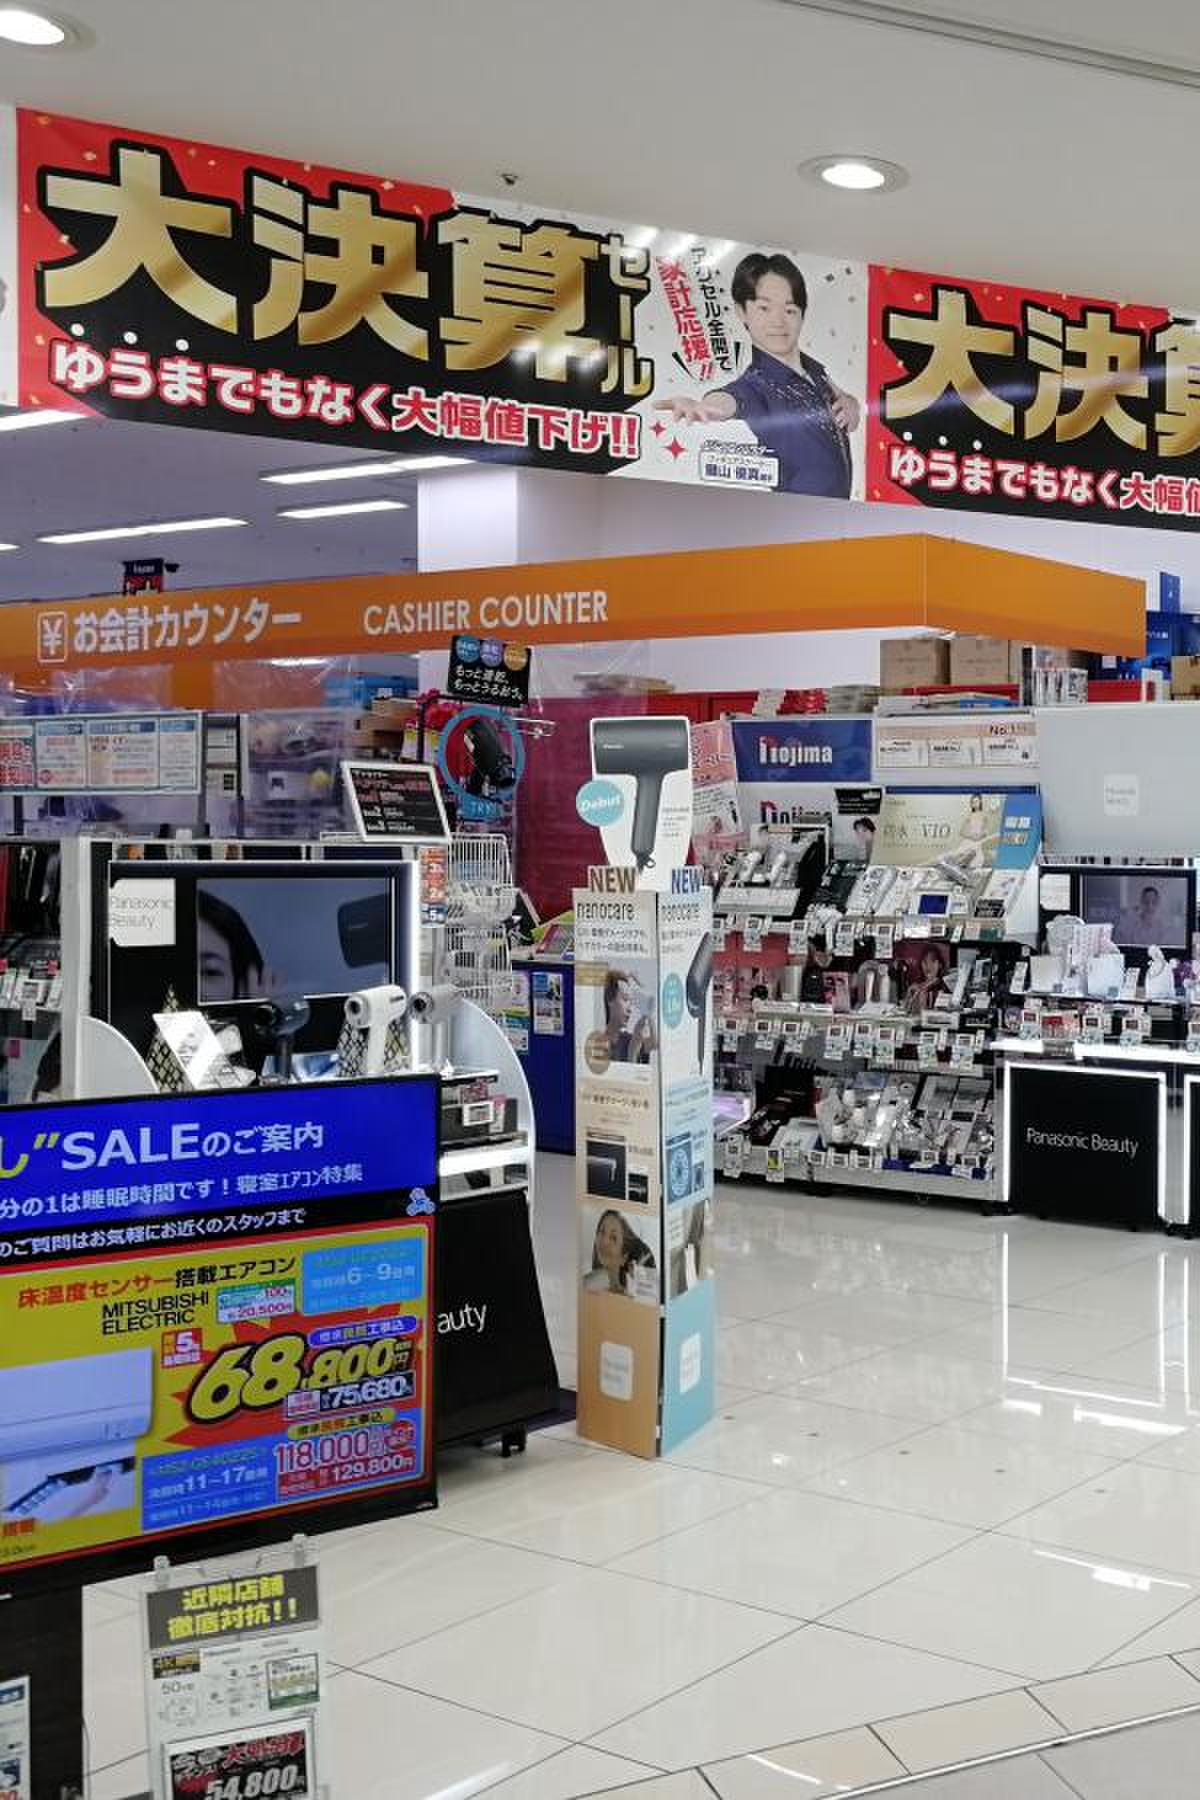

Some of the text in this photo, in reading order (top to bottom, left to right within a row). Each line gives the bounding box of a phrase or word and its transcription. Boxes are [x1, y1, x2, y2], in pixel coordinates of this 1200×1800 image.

[44, 146, 595, 382] 大決算
[600, 235, 653, 397] セール
[74, 598, 302, 654] お会計カウンター
[363, 591, 609, 637] CASHIER COUNTER
[590, 867, 636, 894] NEW
[671, 868, 701, 895] NEW
[577, 902, 635, 921] nanocare
[1026, 1127, 1139, 1158] Panasonic Beauty
[18, 1256, 297, 1308] 床温度センサー搭載エアコン
[102, 1290, 209, 1319] MITSUBISHI
[437, 1303, 487, 1334] auty
[102, 1310, 195, 1336] ELECTRIC
[182, 1574, 285, 1612] 近隣店舗
